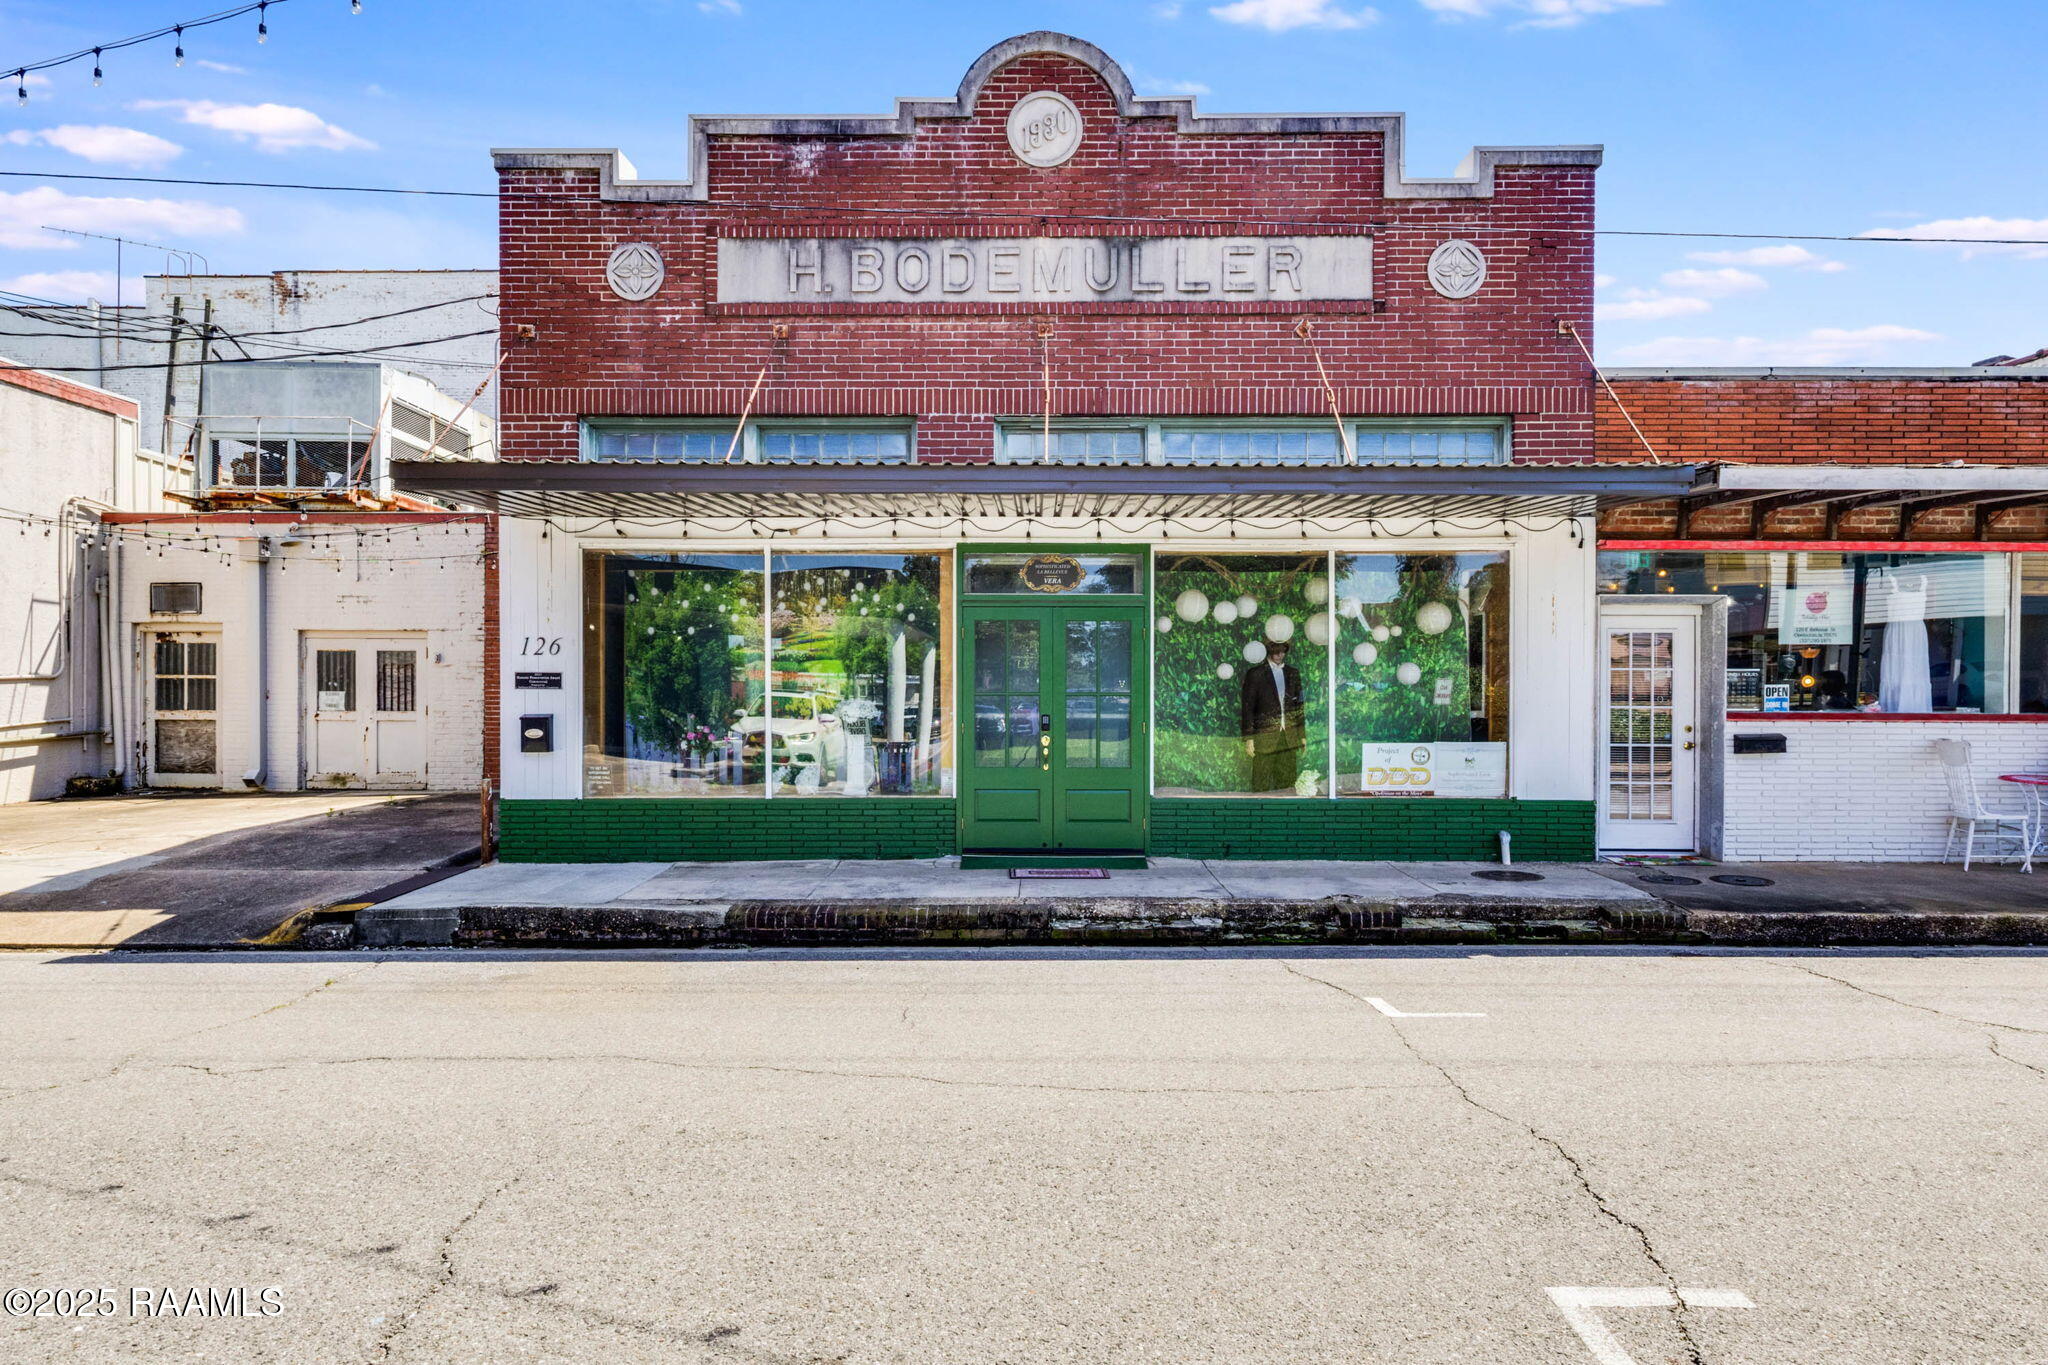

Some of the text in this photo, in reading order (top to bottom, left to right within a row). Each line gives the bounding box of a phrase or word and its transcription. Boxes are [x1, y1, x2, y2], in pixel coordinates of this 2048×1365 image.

[1022, 108, 1071, 154] 1930
[788, 245, 1304, 293] H. BODEMULLER
[520, 637, 563, 656] 126
[1766, 687, 1788, 697] OPEN
[1377, 747, 1400, 755] Project
[1384, 756, 1391, 764] of
[1366, 767, 1431, 786] DDD
